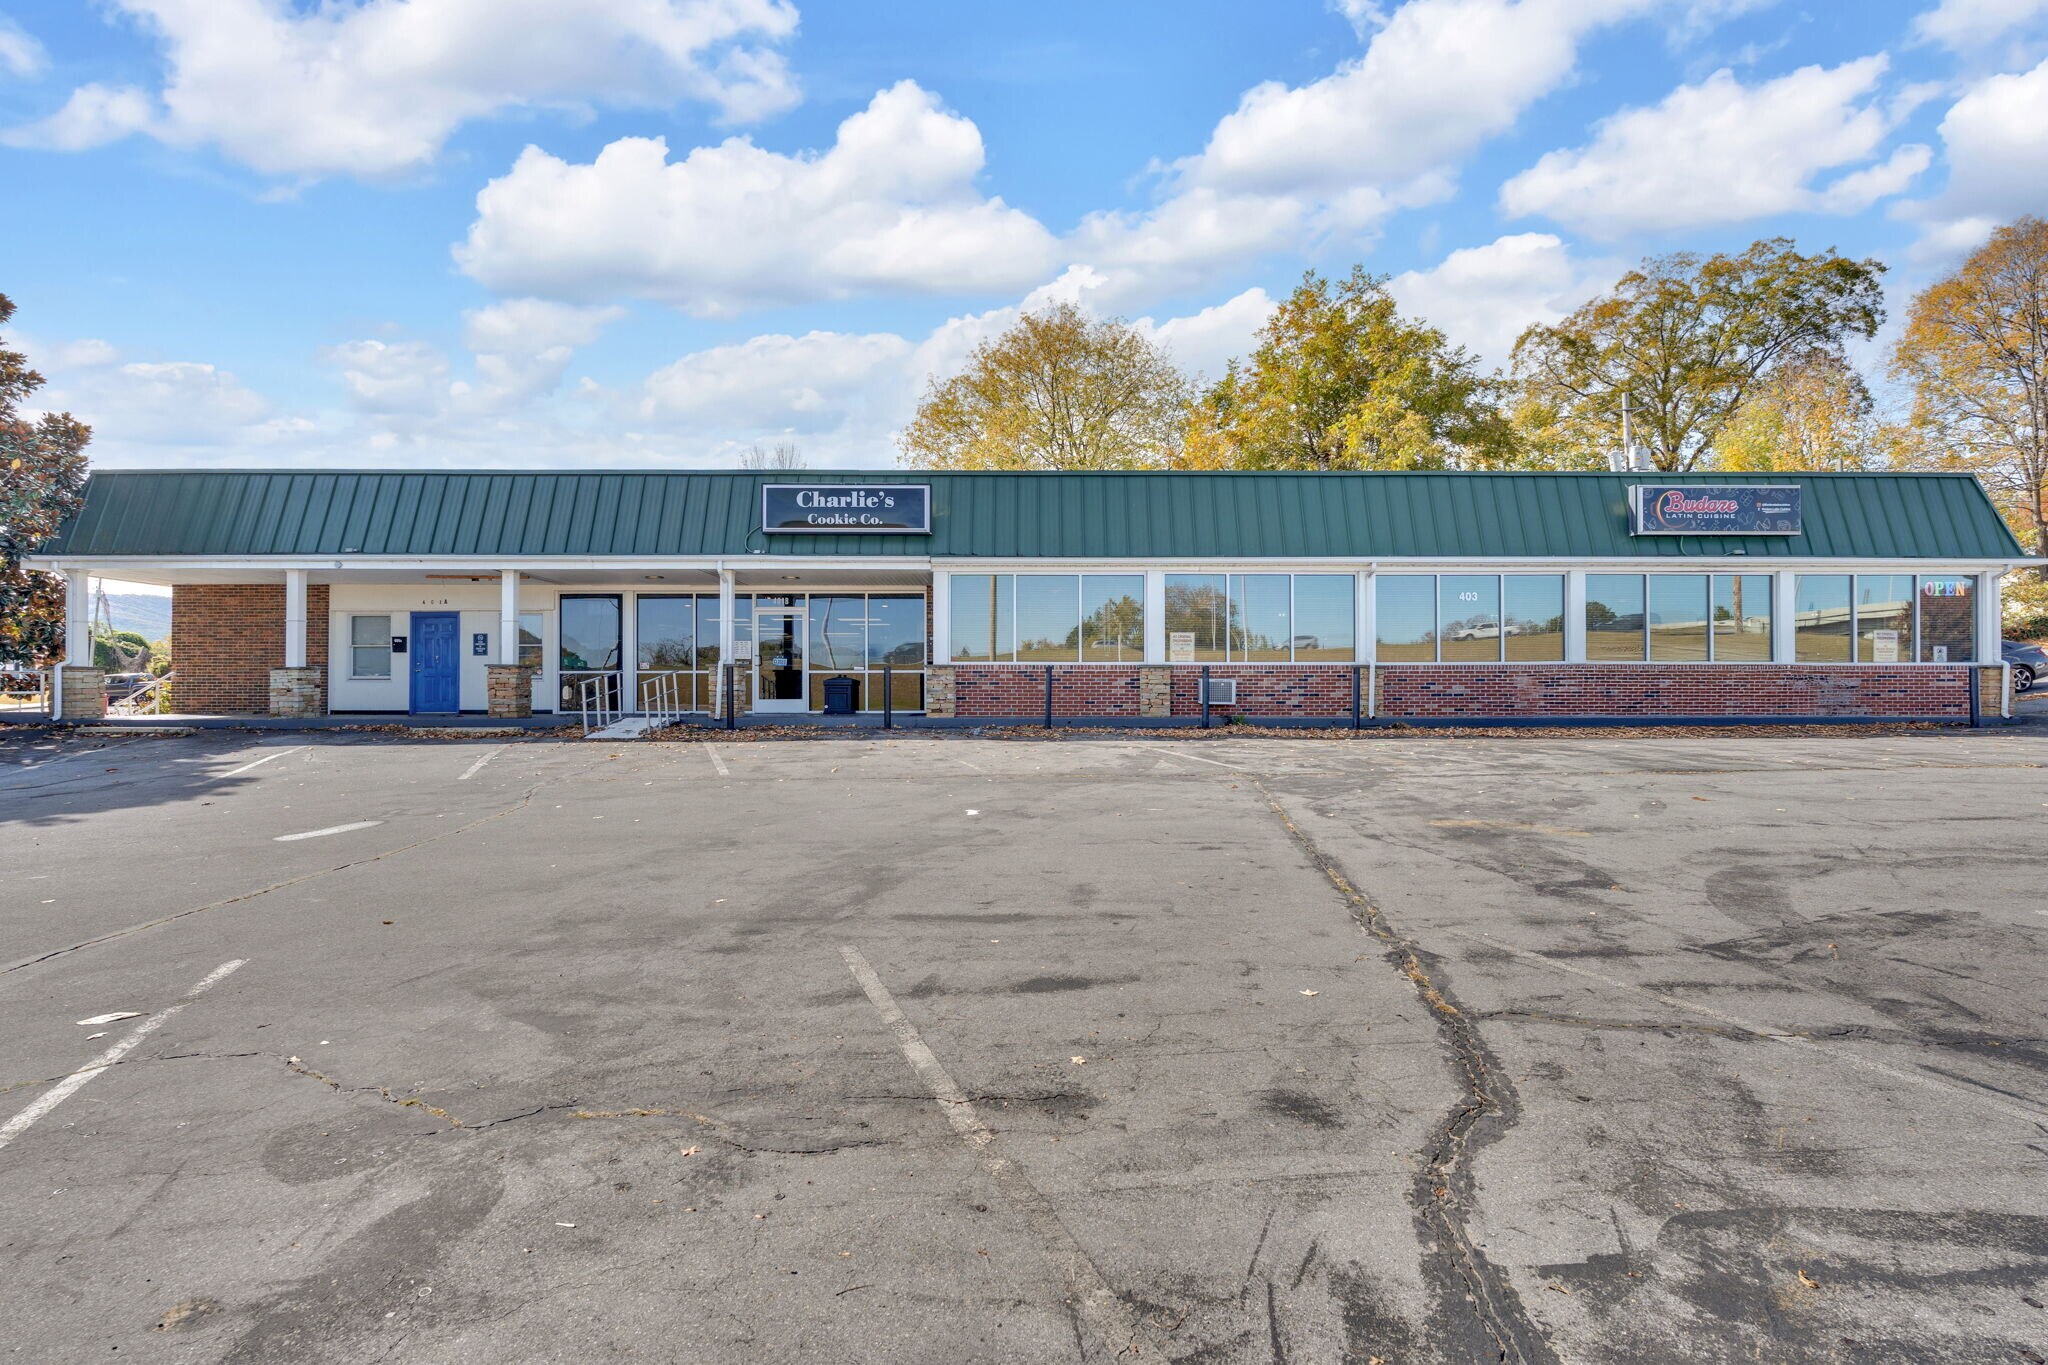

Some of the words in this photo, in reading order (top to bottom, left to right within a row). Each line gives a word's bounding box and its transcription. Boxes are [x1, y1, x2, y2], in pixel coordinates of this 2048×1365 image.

[796, 490, 895, 508] Charlie's
[1664, 490, 1739, 513] Budare
[807, 513, 857, 525] Cookie
[860, 513, 883, 525] Co.
[1459, 591, 1478, 601] 403
[1924, 580, 1966, 597] OPEN
